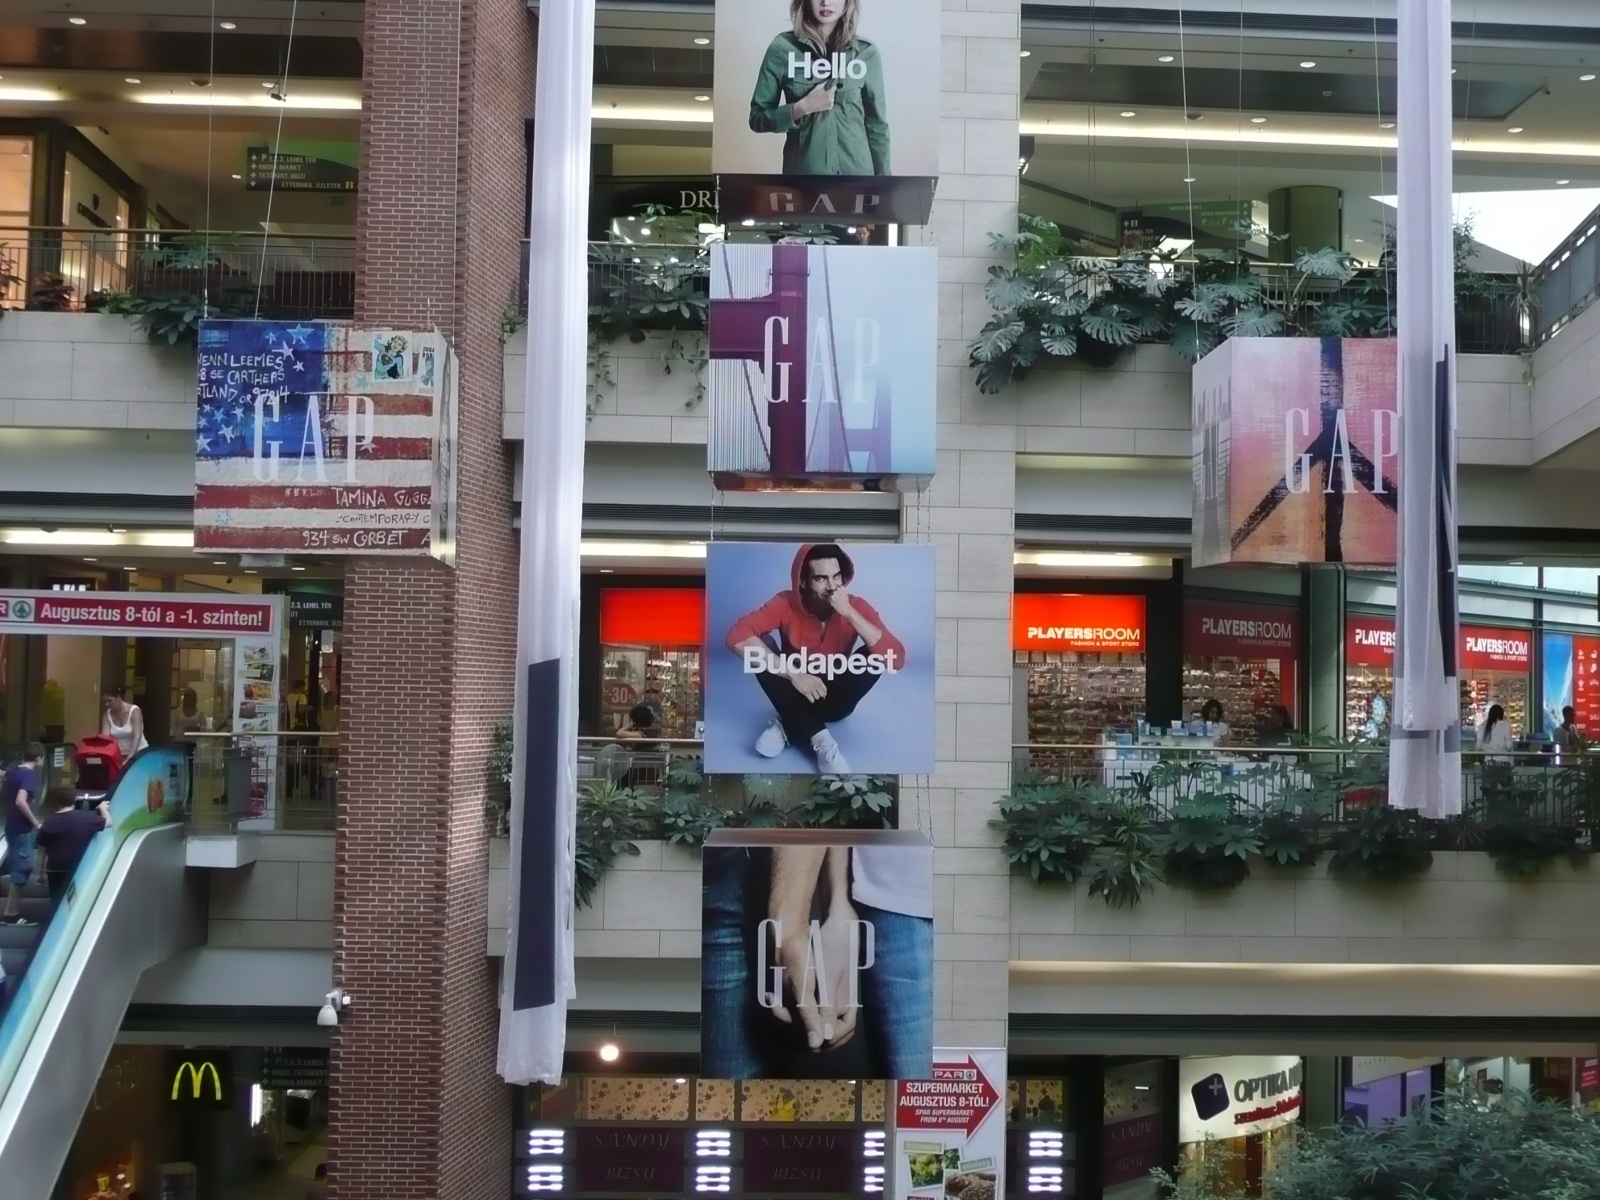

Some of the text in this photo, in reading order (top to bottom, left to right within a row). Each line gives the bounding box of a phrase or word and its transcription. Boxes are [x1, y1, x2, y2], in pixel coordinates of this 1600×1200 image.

[788, 51, 867, 79] Hello
[769, 192, 880, 214] GAP
[230, 353, 284, 370] LEEMES
[764, 315, 880, 403] GAP
[210, 369, 224, 379] SE
[227, 368, 285, 386] CARTHERS
[239, 394, 252, 405] OR
[253, 392, 374, 484] GAP
[1285, 407, 1399, 495] GAP
[302, 530, 329, 547] 934
[40, 602, 121, 623] Augusztus
[125, 605, 161, 622] 8-tól
[165, 610, 175, 623] a
[180, 608, 198, 624] -1.
[202, 609, 262, 626] szinten!
[1027, 626, 1140, 640] PLAYERSROOM
[1202, 617, 1292, 639] PLAYERSROOM
[1466, 636, 1528, 656] PLAYERSROOM
[743, 646, 897, 681] Budapest
[757, 918, 875, 1009] GAP
[905, 1082, 984, 1094] SZUPERMARKET
[1233, 1070, 1289, 1103] OPTIKA
[899, 1093, 990, 1108] AUGUSZTUS 8-TÓL!
[914, 1108, 931, 1116] SPAR
[920, 1116, 937, 1124] FROM
[947, 1116, 970, 1124] AUGUST
